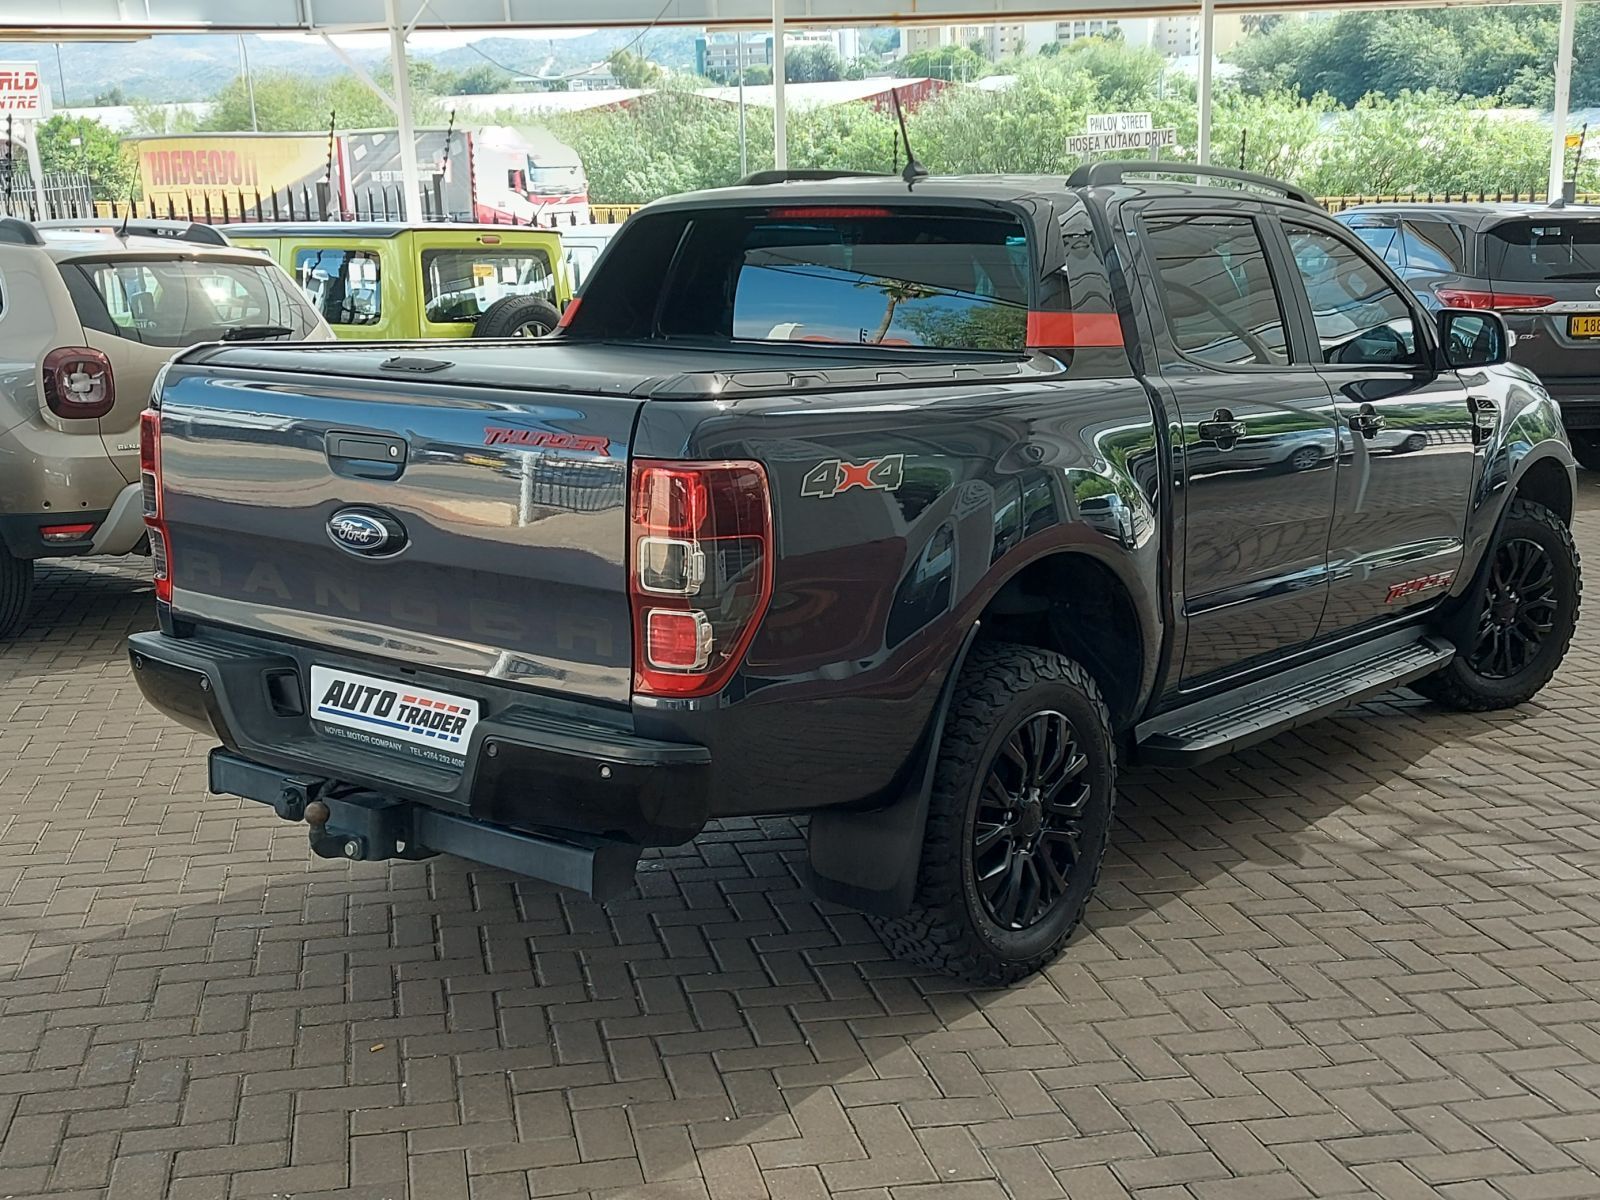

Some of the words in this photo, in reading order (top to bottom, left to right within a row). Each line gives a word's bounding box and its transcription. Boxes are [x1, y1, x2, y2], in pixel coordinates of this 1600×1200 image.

[1089, 115, 1118, 131] PAVLOV
[1121, 114, 1148, 131] STREET
[1069, 137, 1101, 152] HOSEA
[1104, 133, 1141, 150] KUTAKO
[1144, 130, 1174, 147] DRIVE
[1573, 319, 1580, 333] N
[483, 425, 611, 457] THUNDER
[338, 519, 371, 543] Ford
[181, 549, 612, 658] RANGER
[320, 679, 398, 718] AUTO
[396, 703, 469, 736] TRADER
[324, 725, 346, 738] NOVEL
[346, 731, 371, 744] MOTOR
[370, 736, 403, 752] COMPANY
[409, 746, 423, 757] TEL
